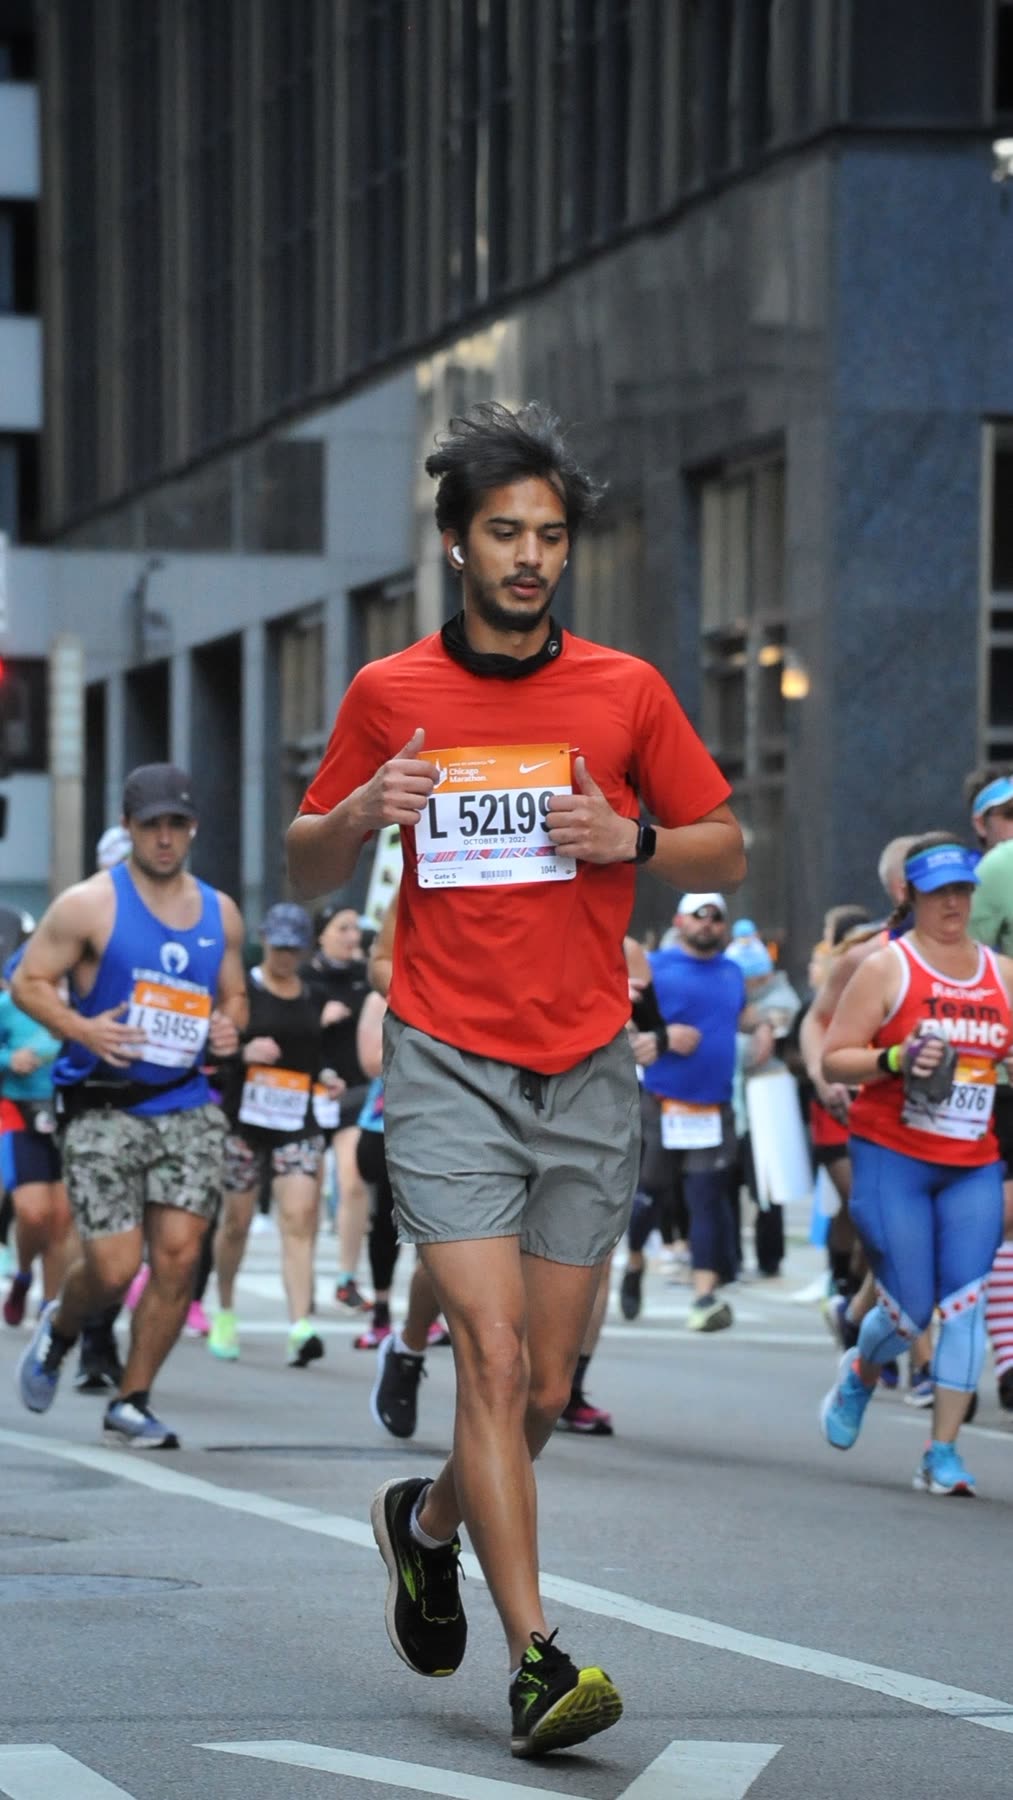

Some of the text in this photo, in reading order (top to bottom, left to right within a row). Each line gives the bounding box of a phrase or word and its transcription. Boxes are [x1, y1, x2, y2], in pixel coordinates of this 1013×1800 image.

[449, 768, 479, 778] Chicago
[428, 797, 448, 839] L
[463, 837, 498, 846] OCTOBER
[541, 865, 557, 874] 1044
[923, 996, 1002, 1024] Team
